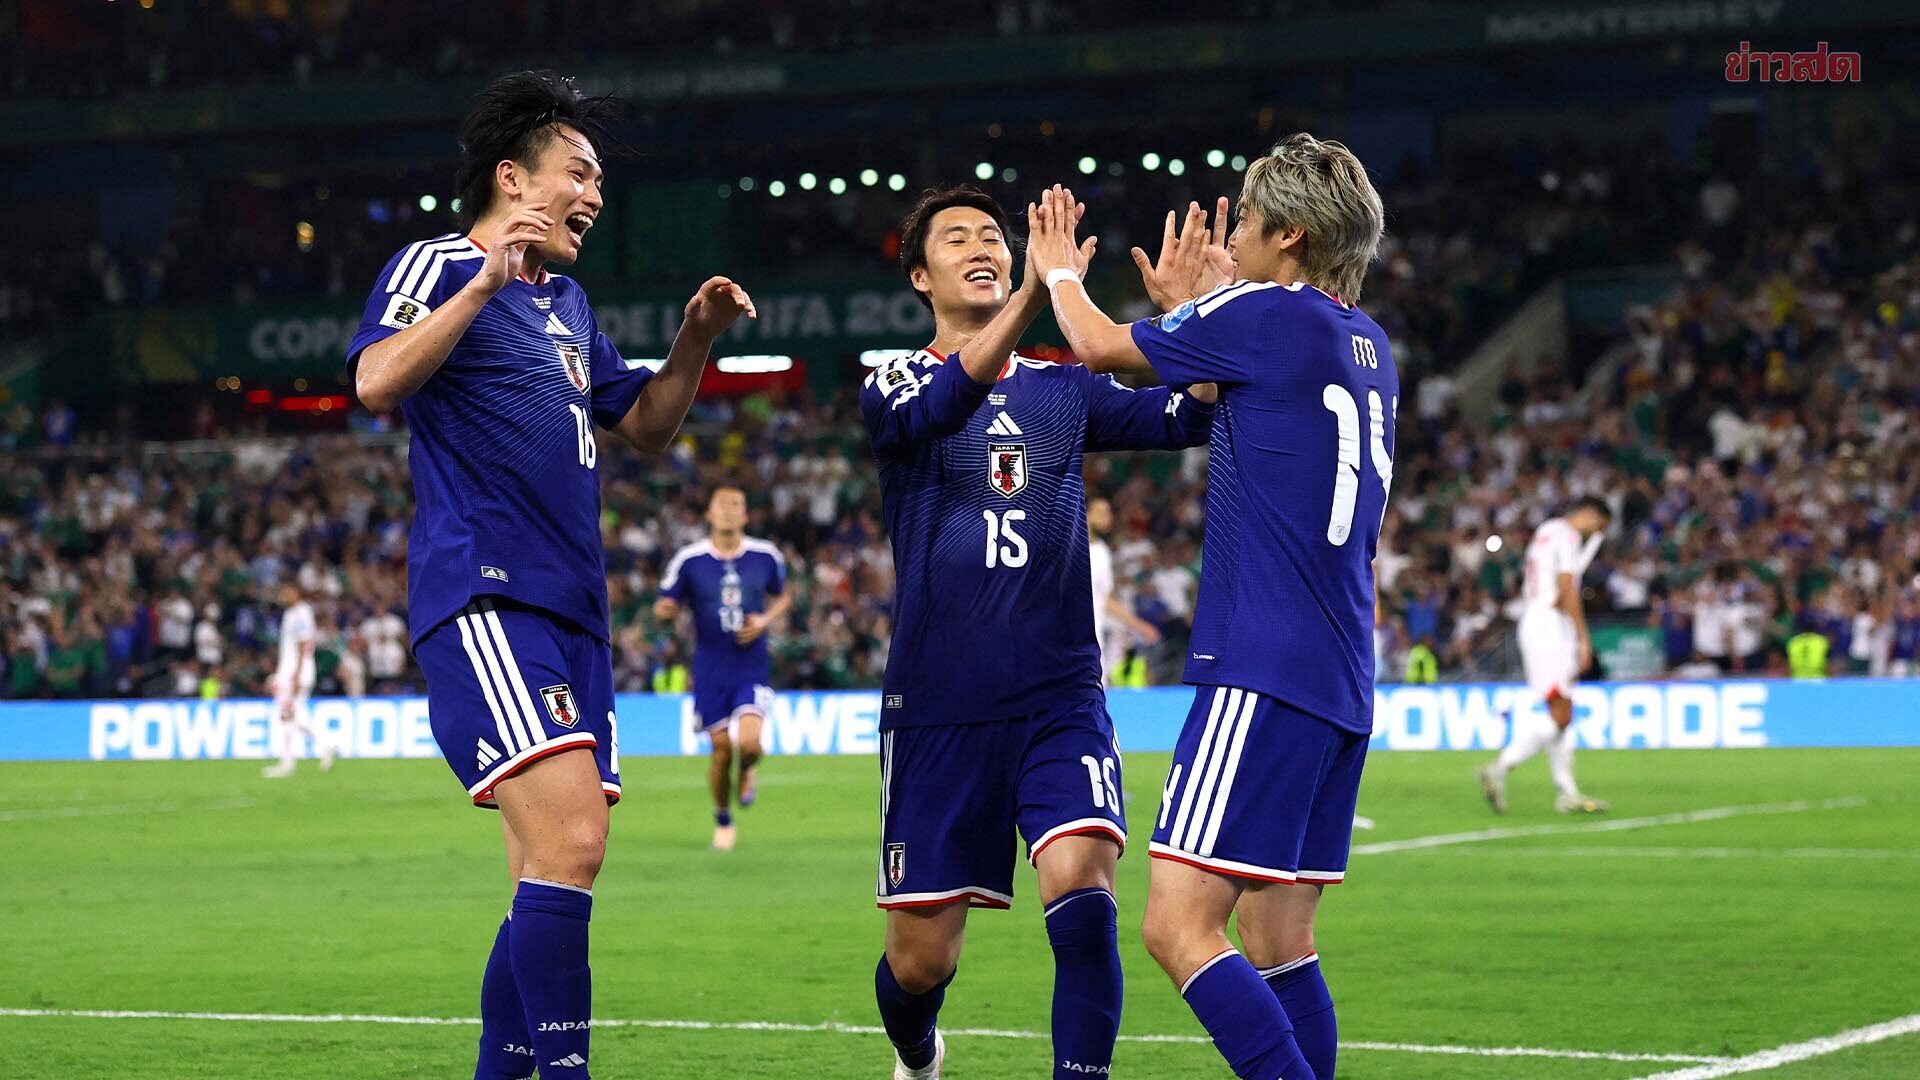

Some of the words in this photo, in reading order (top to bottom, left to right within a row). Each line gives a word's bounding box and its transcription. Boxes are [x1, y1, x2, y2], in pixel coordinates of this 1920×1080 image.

[1352, 334, 1378, 370] ITO
[983, 509, 1028, 569] 15
[1081, 755, 1120, 817] 15
[1062, 1060, 1112, 1075] JAPA
